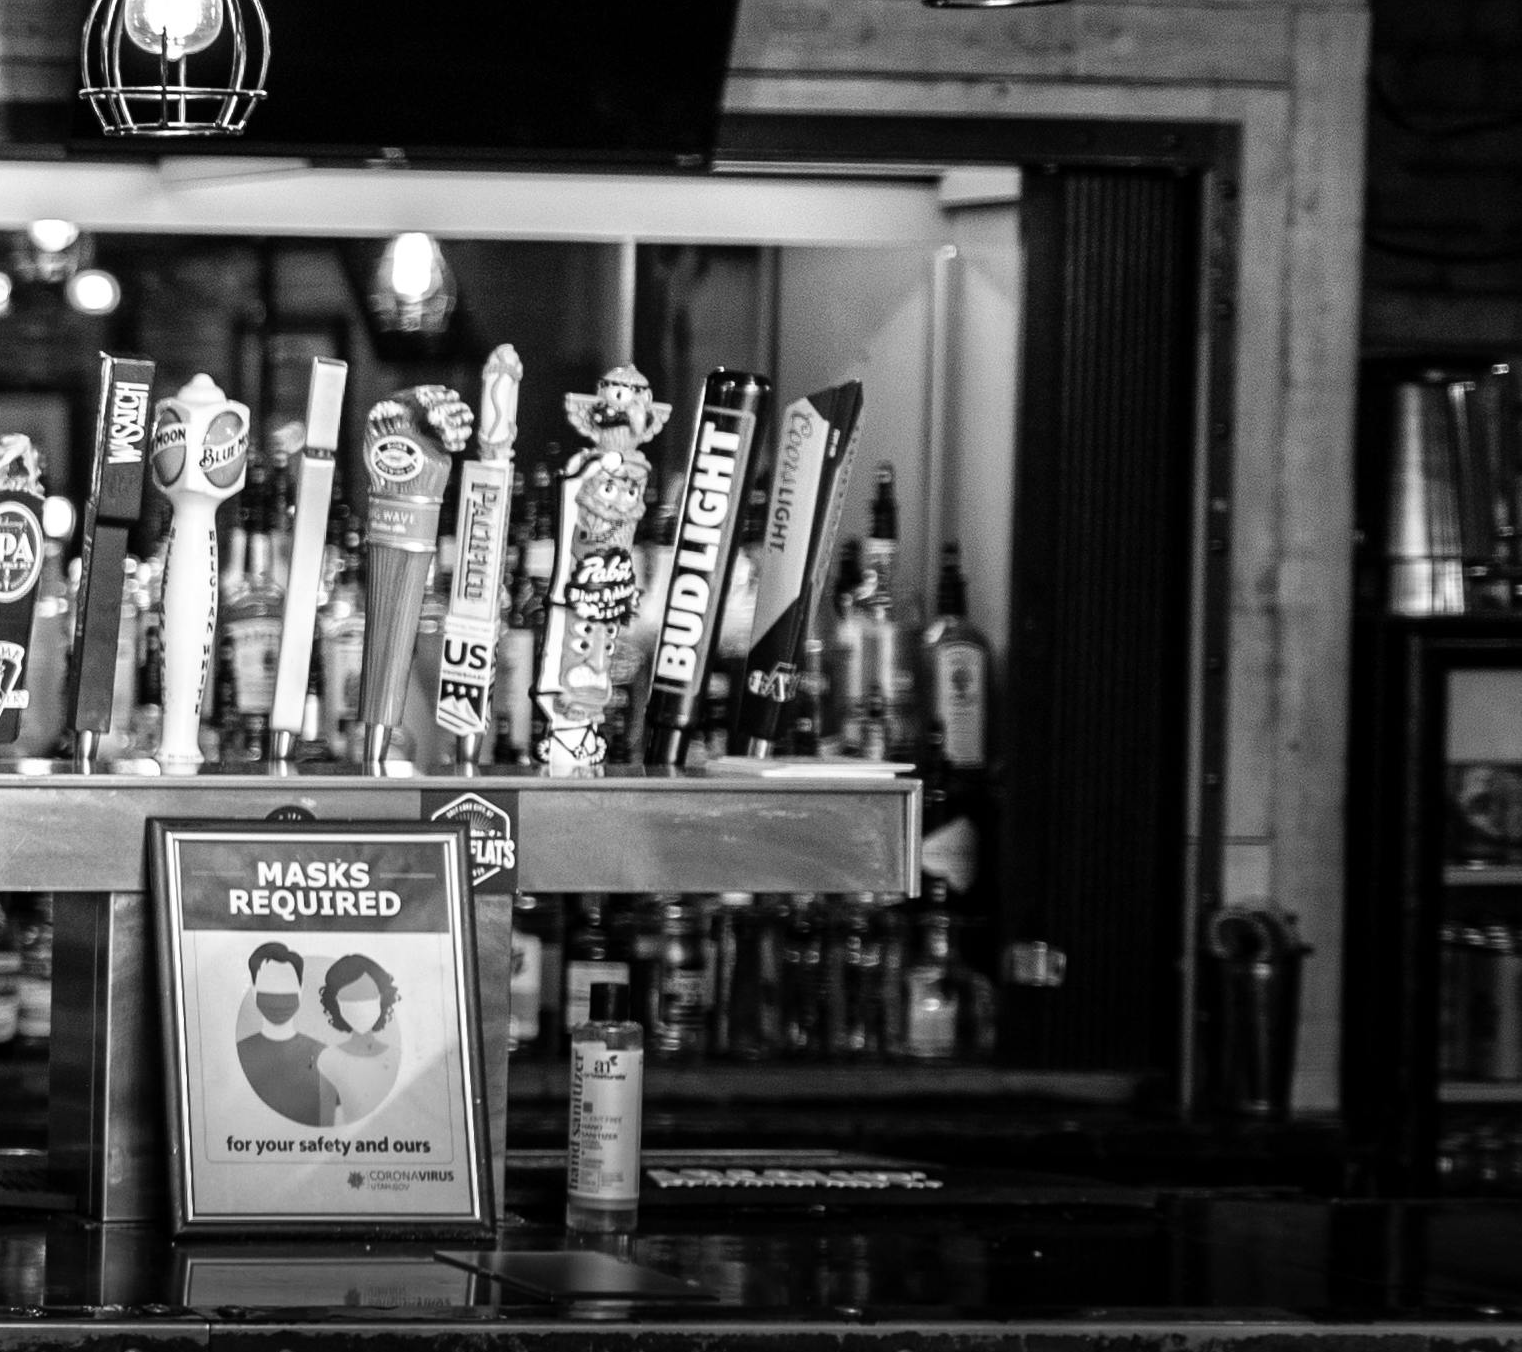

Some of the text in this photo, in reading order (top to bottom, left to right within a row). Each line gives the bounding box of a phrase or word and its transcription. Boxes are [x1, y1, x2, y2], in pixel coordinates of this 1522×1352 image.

[198, 445, 237, 469] BLUE
[766, 484, 795, 554] LIGHT
[658, 420, 743, 683] BUD LIGHT
[577, 554, 632, 584] Pabst
[570, 587, 601, 602] Blue
[444, 639, 488, 671] US
[258, 861, 370, 888] MASKS
[229, 889, 402, 920] REQUIRED
[226, 1135, 432, 1156] for your safety and ours
[369, 1170, 455, 1182] CORONAVIRUS
